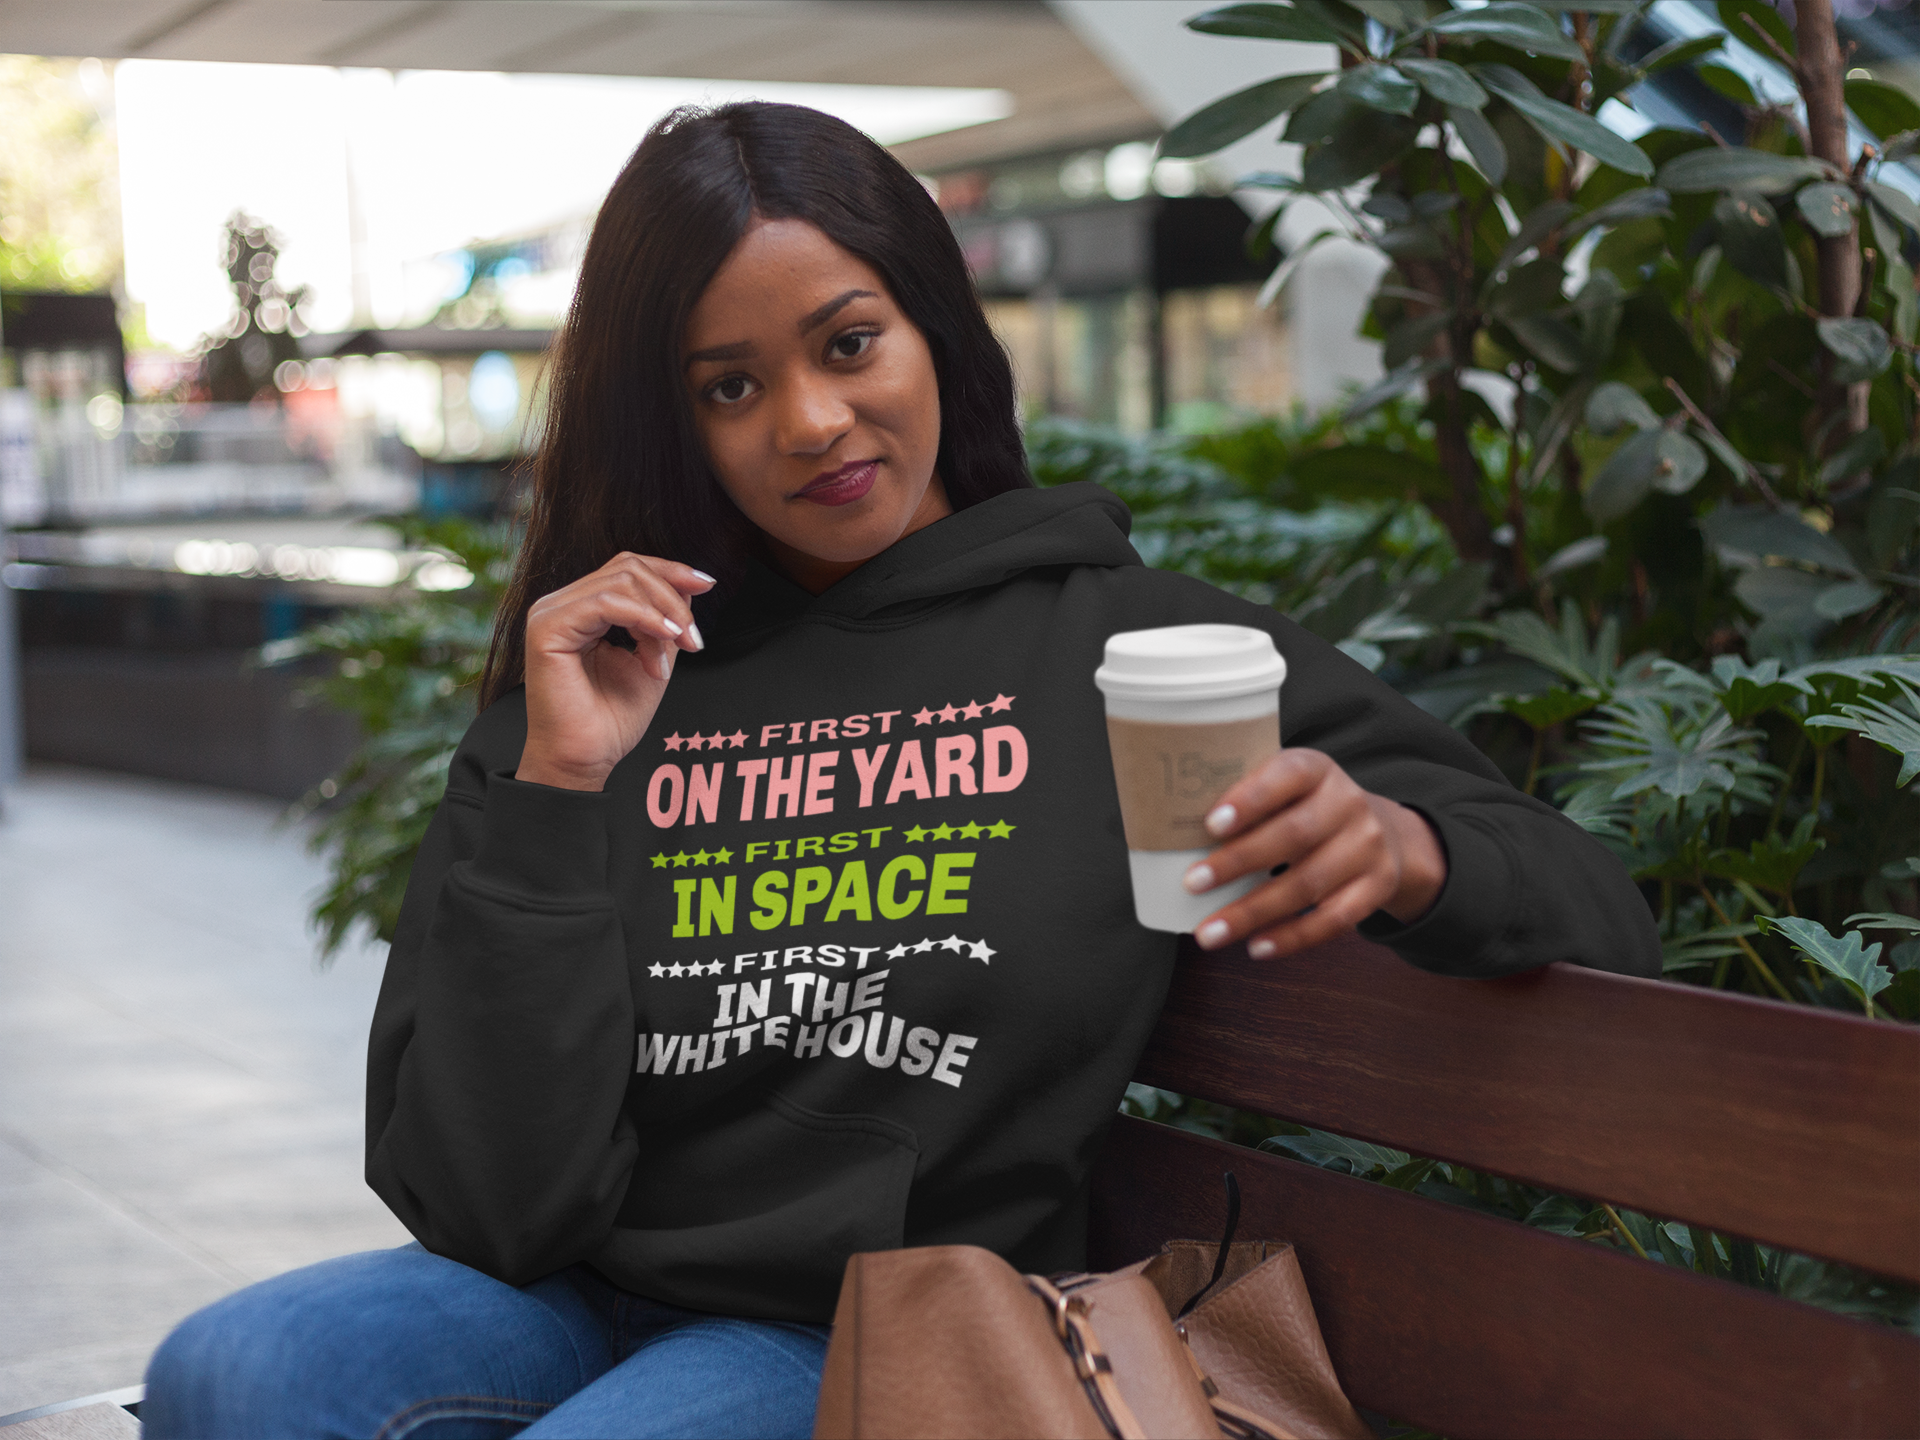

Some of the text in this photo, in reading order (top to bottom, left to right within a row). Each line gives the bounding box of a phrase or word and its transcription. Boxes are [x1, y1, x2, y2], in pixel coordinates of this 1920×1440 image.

[759, 710, 902, 748] FIRST
[646, 725, 1029, 829] ON THE YARD
[745, 826, 893, 864] FIRST
[672, 852, 978, 938] IN SPACE
[733, 944, 881, 975] FIRST
[712, 969, 890, 1029] IN THE
